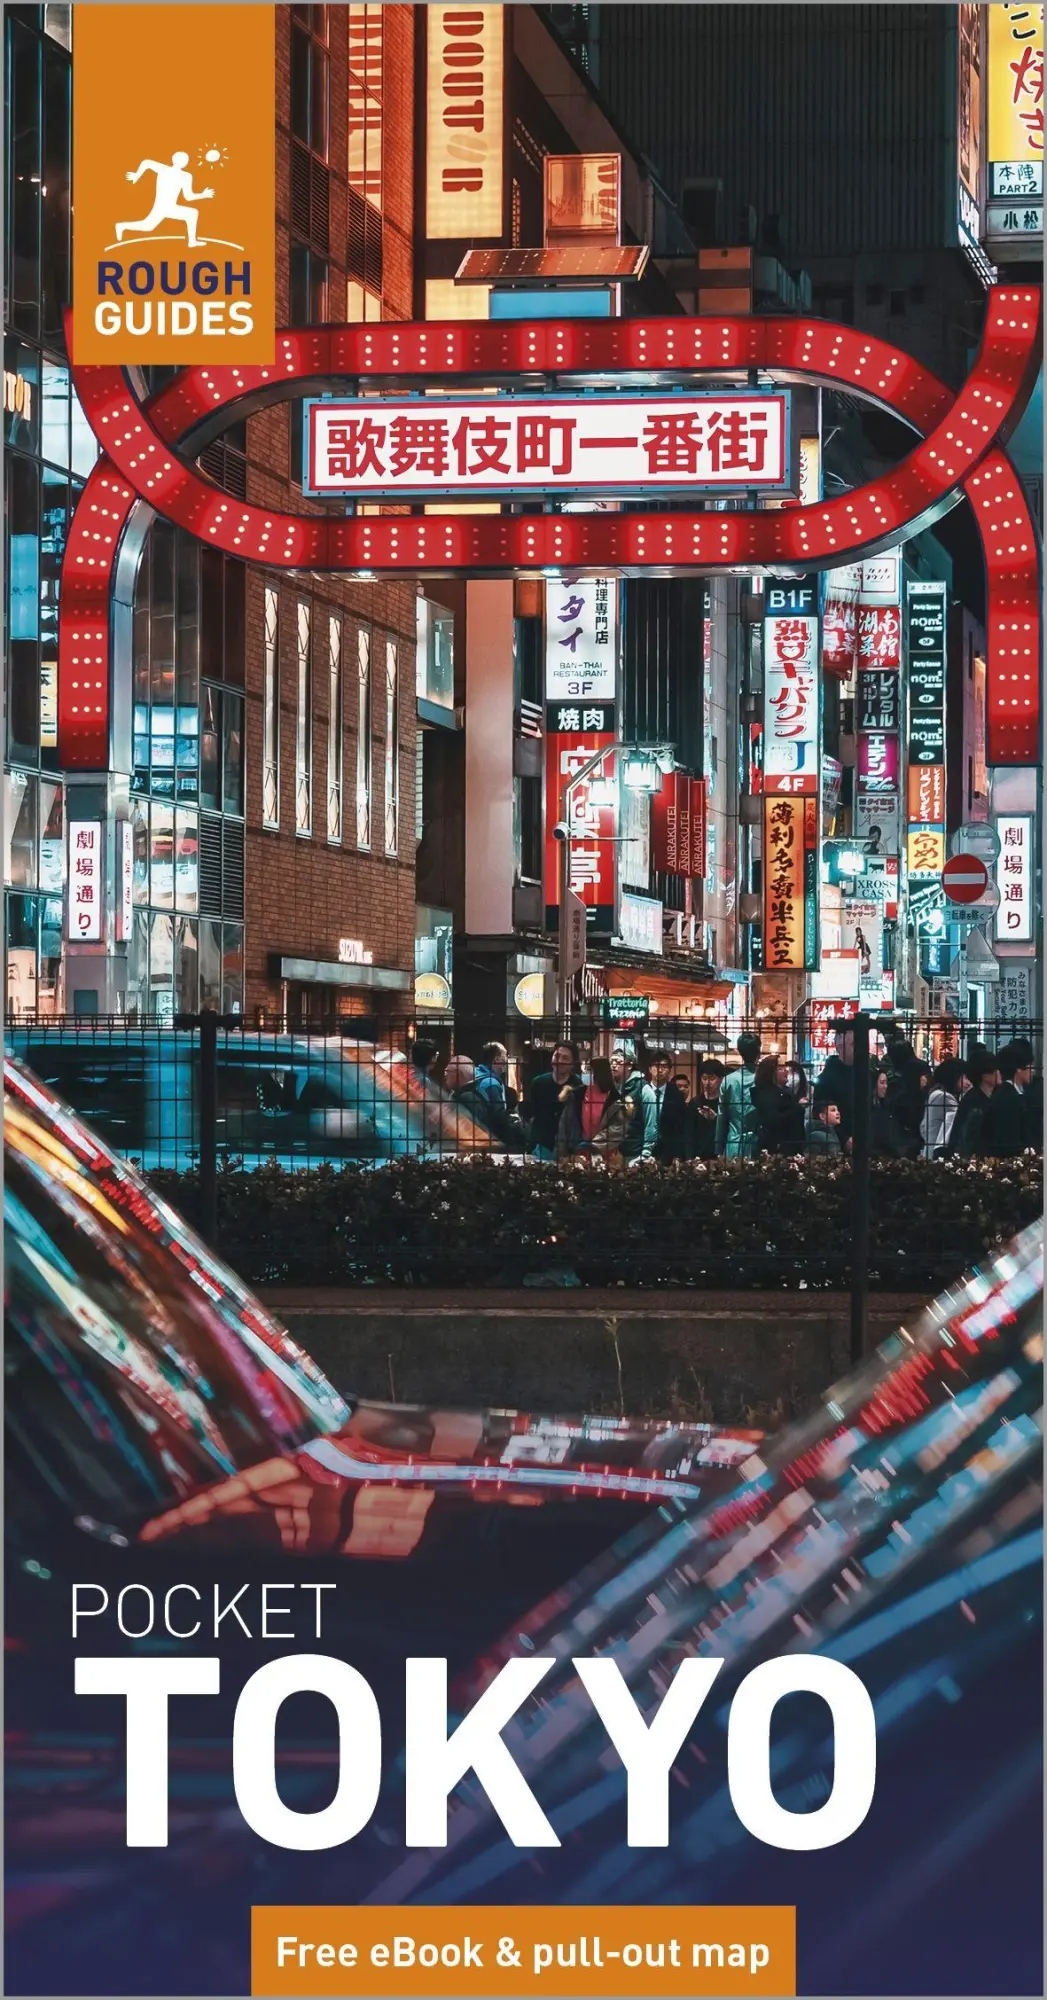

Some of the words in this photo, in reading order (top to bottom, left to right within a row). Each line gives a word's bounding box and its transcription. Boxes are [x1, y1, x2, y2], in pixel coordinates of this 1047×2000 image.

[1003, 210, 1039, 230] 小松
[326, 413, 768, 478] 歌舞伎町一番街
[769, 589, 813, 608] B1F
[567, 681, 594, 695] 3F
[880, 672, 895, 727] レンタル
[557, 708, 605, 731] 焼肉
[777, 775, 805, 792] 4F
[667, 804, 677, 868] ANRAKUTEI
[680, 810, 689, 872] ANRAKUTEI
[693, 814, 702, 875] ANRAKUTEI
[914, 833, 939, 869] らーめん
[76, 831, 94, 930] 劇場通り
[857, 880, 897, 889] XROSS
[1004, 827, 1023, 929] 劇場通り
[861, 888, 892, 898] CASA
[608, 997, 648, 1008] Trattoria
